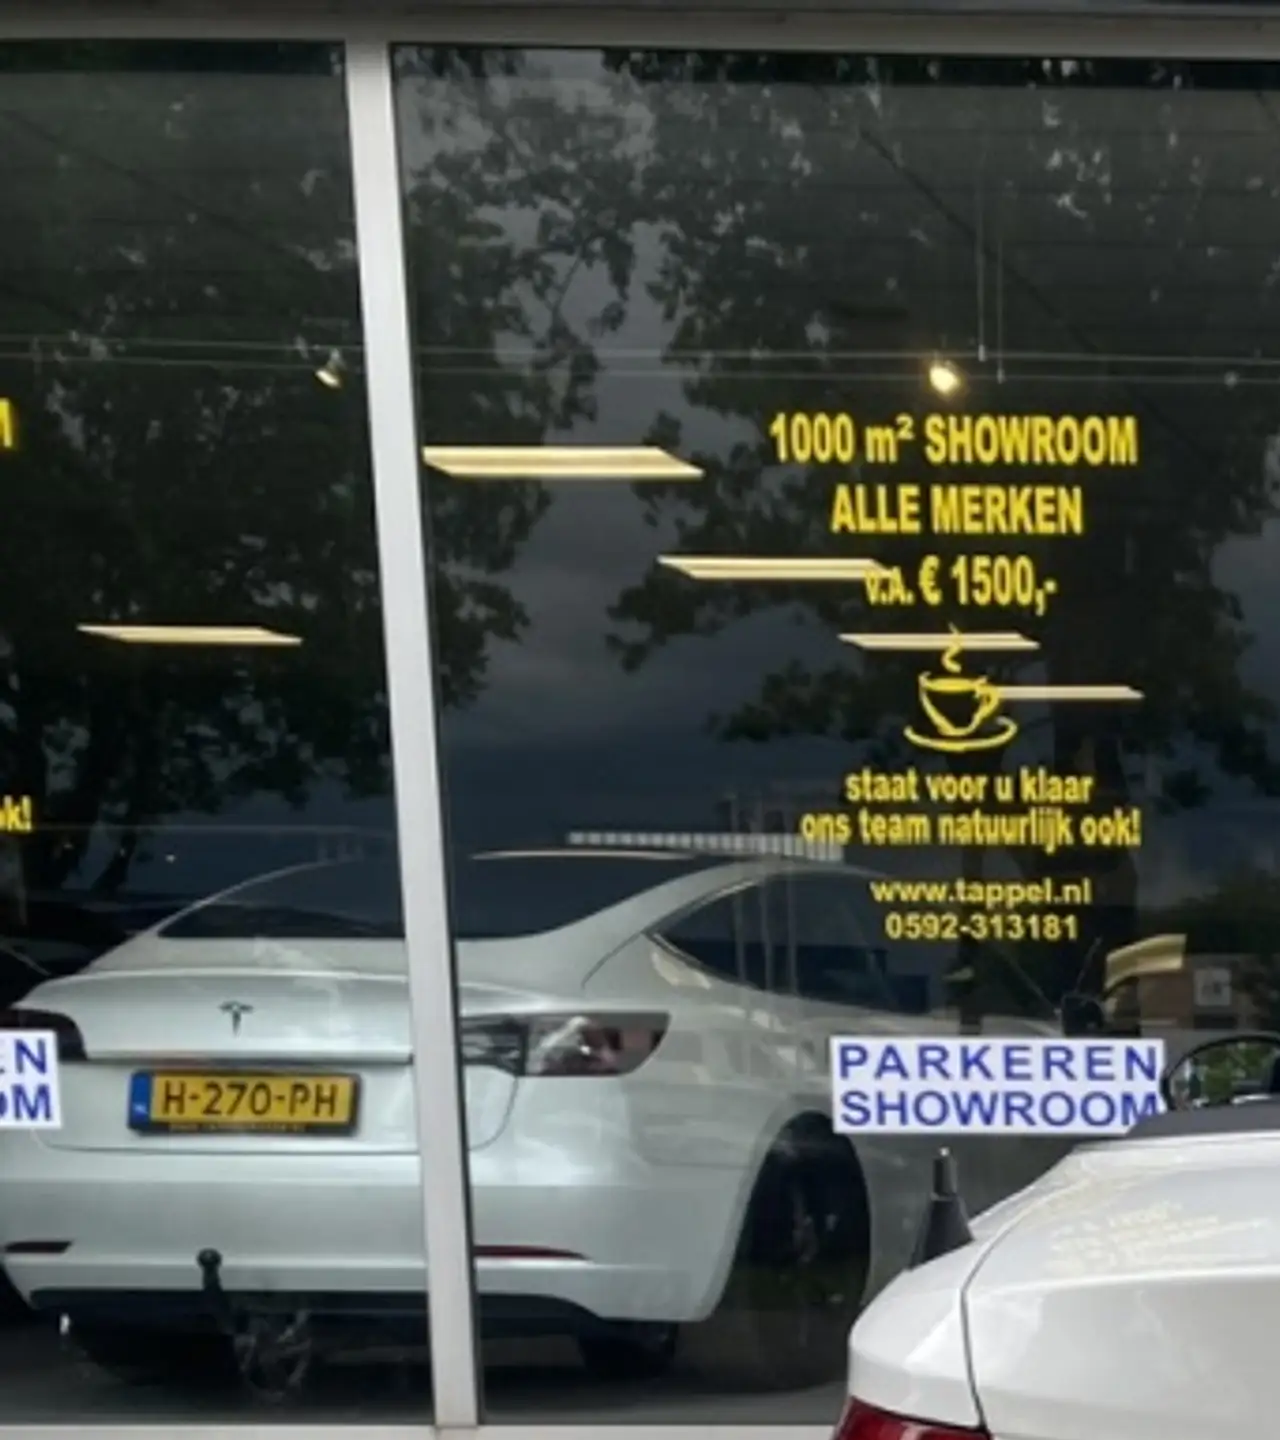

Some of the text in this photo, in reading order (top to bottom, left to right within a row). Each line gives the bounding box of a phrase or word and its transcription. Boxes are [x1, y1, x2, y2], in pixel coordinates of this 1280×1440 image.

[769, 412, 1139, 465] 1000 m² SHOWROOM
[830, 484, 1083, 535] ALLE MERKEN
[919, 555, 940, 605] €
[950, 554, 1058, 617] 1500,-
[846, 767, 1094, 803] staat voor u klaar
[802, 808, 1142, 853] ons team natuurlijk ook!
[870, 878, 1093, 906] www.tappel.nl
[884, 913, 1079, 940] 0592-313181
[838, 1044, 1157, 1082] PARKEREN
[162, 1079, 339, 1117] H-270-PH
[840, 1089, 1157, 1127] SHOWROOM
